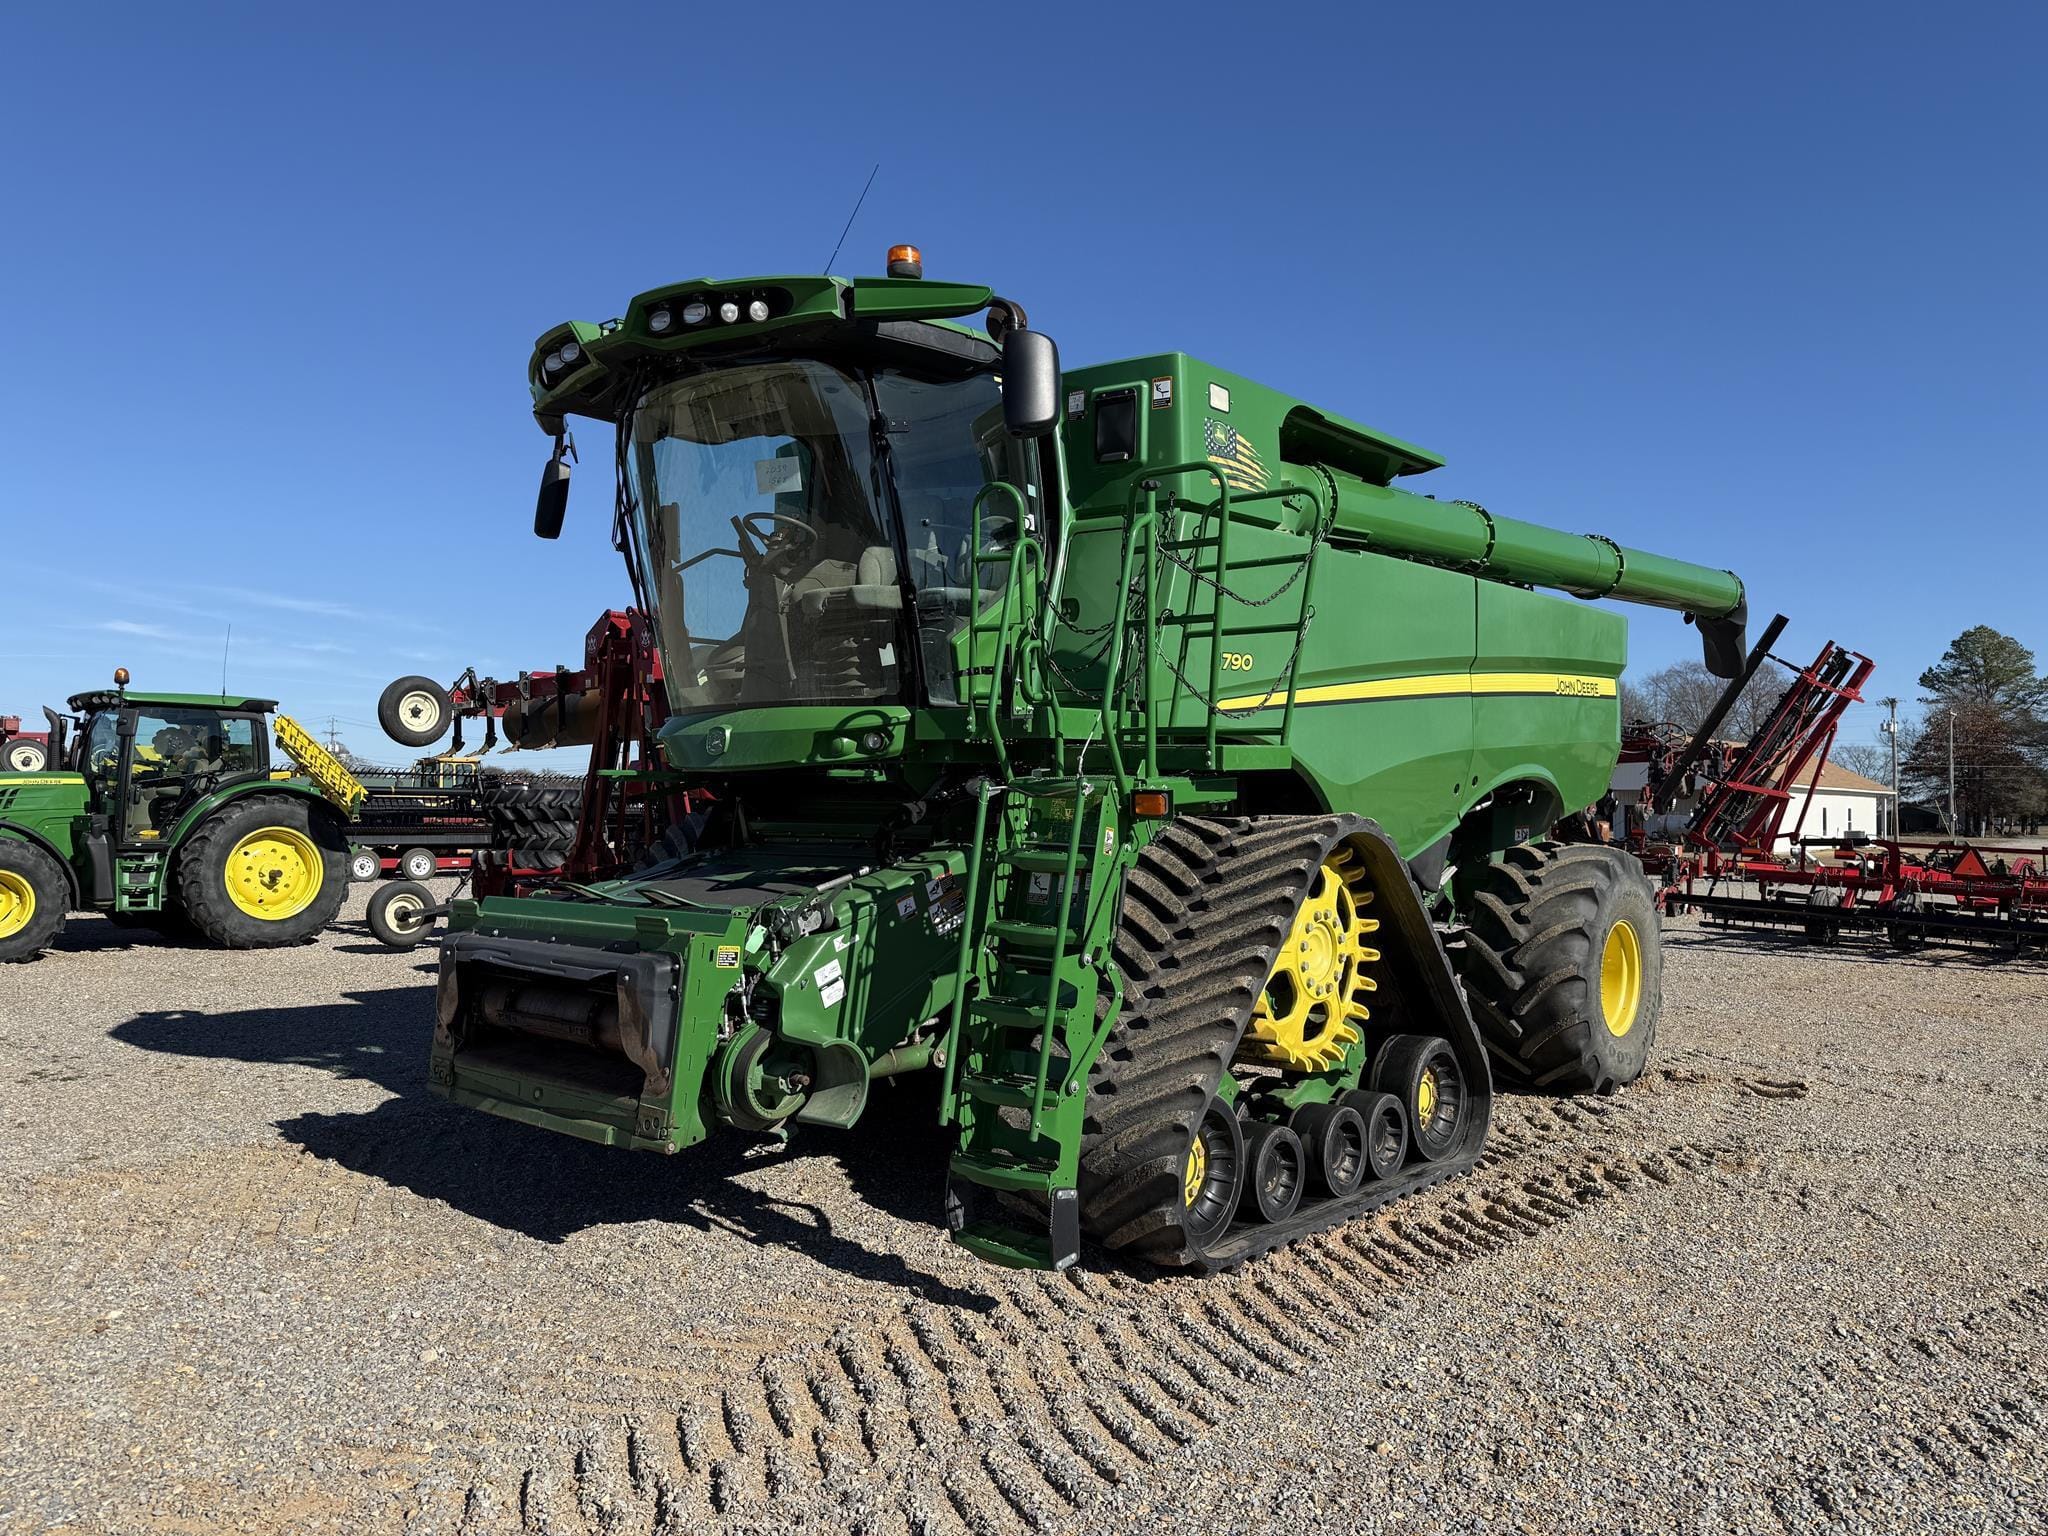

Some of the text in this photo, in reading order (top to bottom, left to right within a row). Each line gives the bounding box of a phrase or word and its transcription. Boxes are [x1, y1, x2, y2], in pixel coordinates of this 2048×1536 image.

[1221, 652, 1254, 671] 790
[1555, 677, 1600, 695] JOHN DEERE
